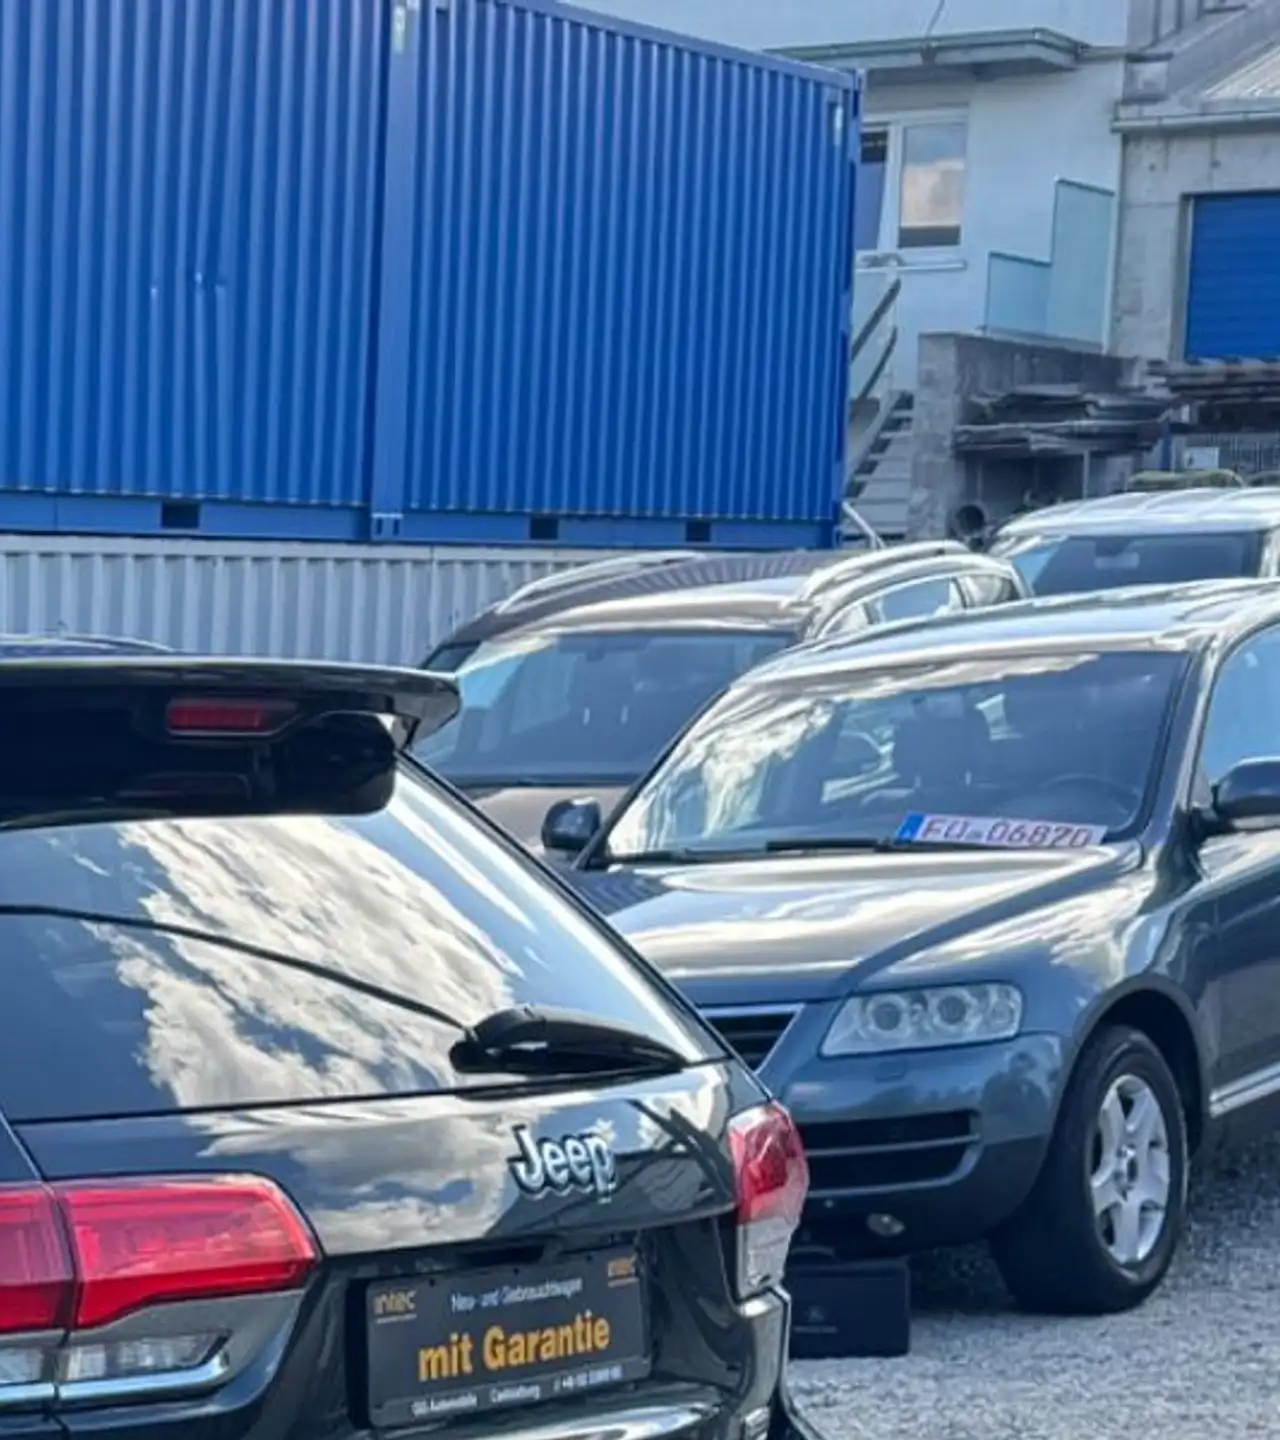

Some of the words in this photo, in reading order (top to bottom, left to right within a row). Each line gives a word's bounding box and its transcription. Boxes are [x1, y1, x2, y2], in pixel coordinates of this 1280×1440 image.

[507, 1123, 616, 1196] Jeep
[419, 1332, 473, 1381] mit
[483, 1309, 609, 1371] Garantie
